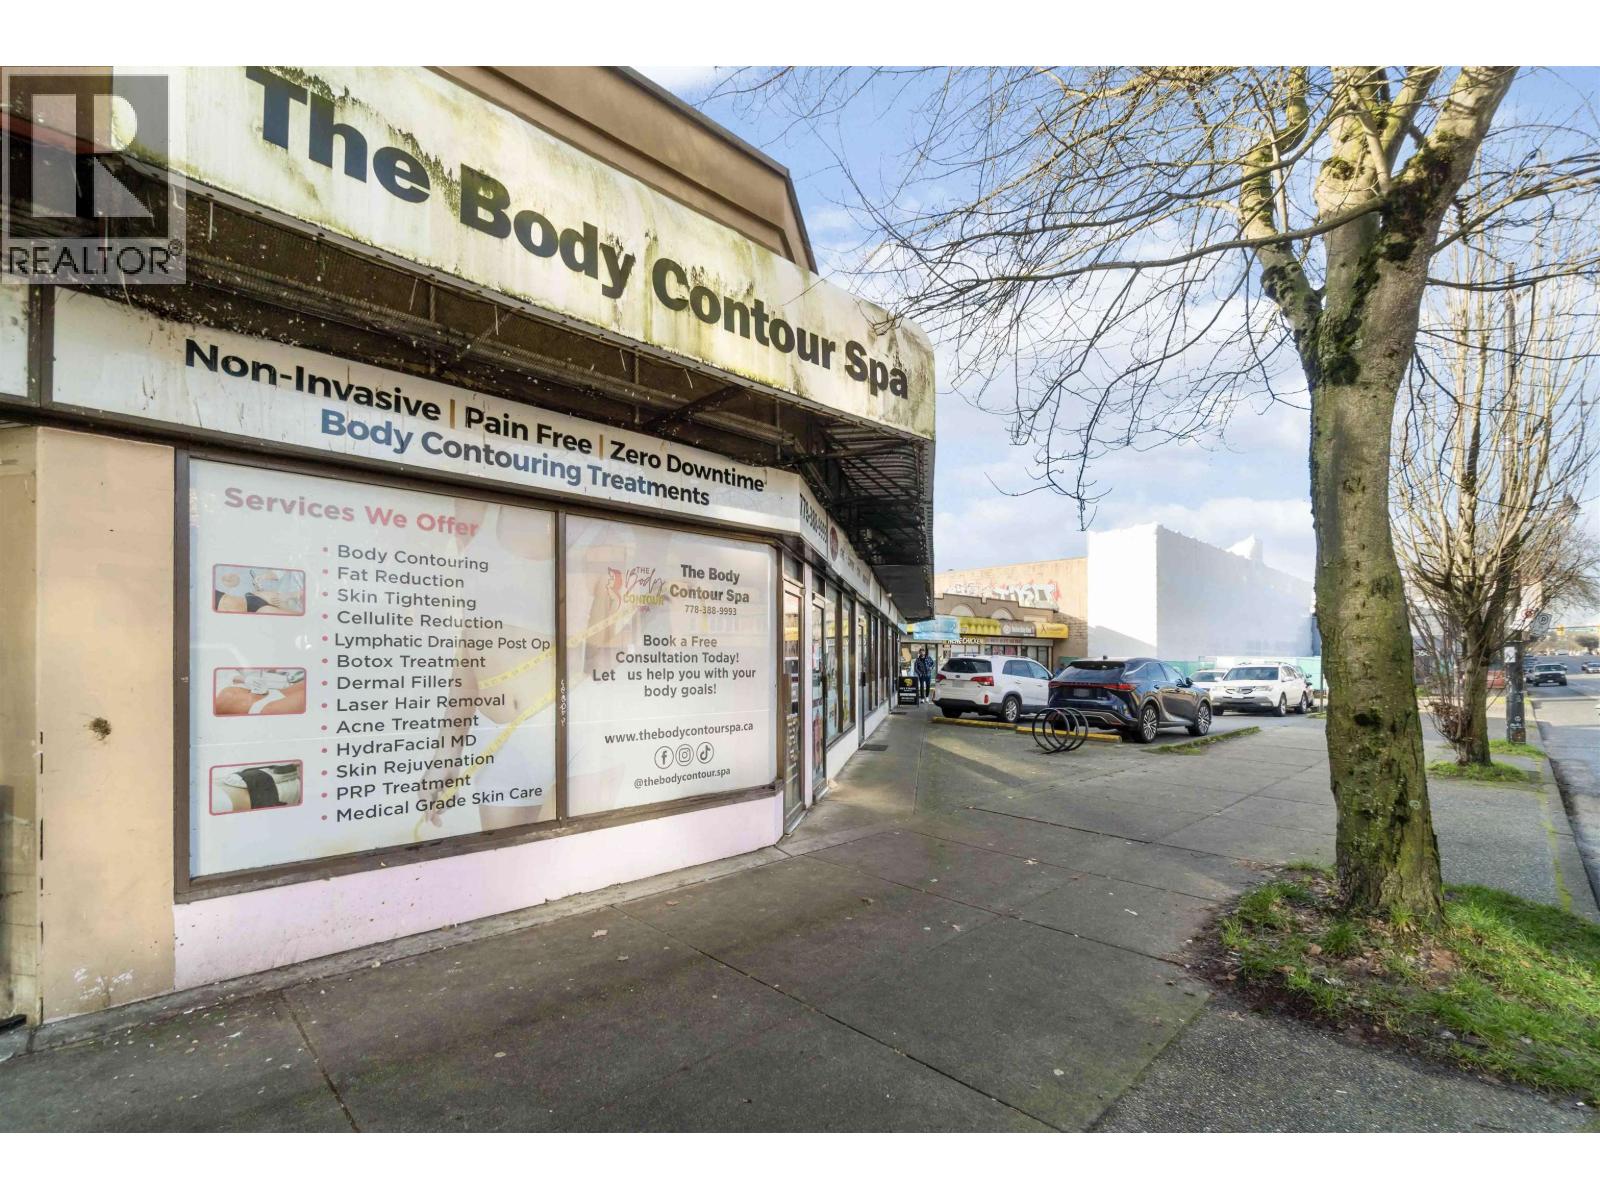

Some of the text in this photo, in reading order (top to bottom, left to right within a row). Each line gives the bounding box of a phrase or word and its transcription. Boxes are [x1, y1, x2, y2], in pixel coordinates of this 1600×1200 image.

[246, 66, 909, 400] The Body Contour Spa
[185, 338, 765, 493] Non-Invasive Pain Free Zero Downtime
[320, 409, 710, 506] Body Contouring Treatments
[224, 487, 480, 538] Services We Offer
[337, 544, 489, 573] Body Contouring
[337, 567, 465, 588] Fat Reduction
[681, 564, 740, 585] The Body
[337, 589, 477, 611] Skin Tightening
[670, 585, 749, 604] Contour Spa
[337, 611, 503, 630] Cellulite Reduction
[685, 604, 737, 616] 778-388-9993
[335, 632, 551, 651] Lymphatic Drainage Post Op
[643, 635, 718, 647] Book a Free
[337, 655, 486, 668] Botox Treatment
[616, 651, 739, 665] Consultation Today!
[337, 675, 463, 690] Dermal Fillers
[592, 667, 756, 683] Let us help you with your
[644, 683, 717, 698] body goals!
[337, 694, 506, 712] Laser Hair Removal
[336, 715, 479, 734] Acne Treatment
[605, 722, 754, 744] www.thebodycontourspa.ca
[337, 734, 476, 758] HydraFacial MD
[336, 753, 494, 778] Skin Rejuvenation
[337, 774, 471, 801] PRP Treatment
[634, 767, 731, 789] @thebodycontour.spa
[337, 786, 543, 823] Medical Grade Skin Care
